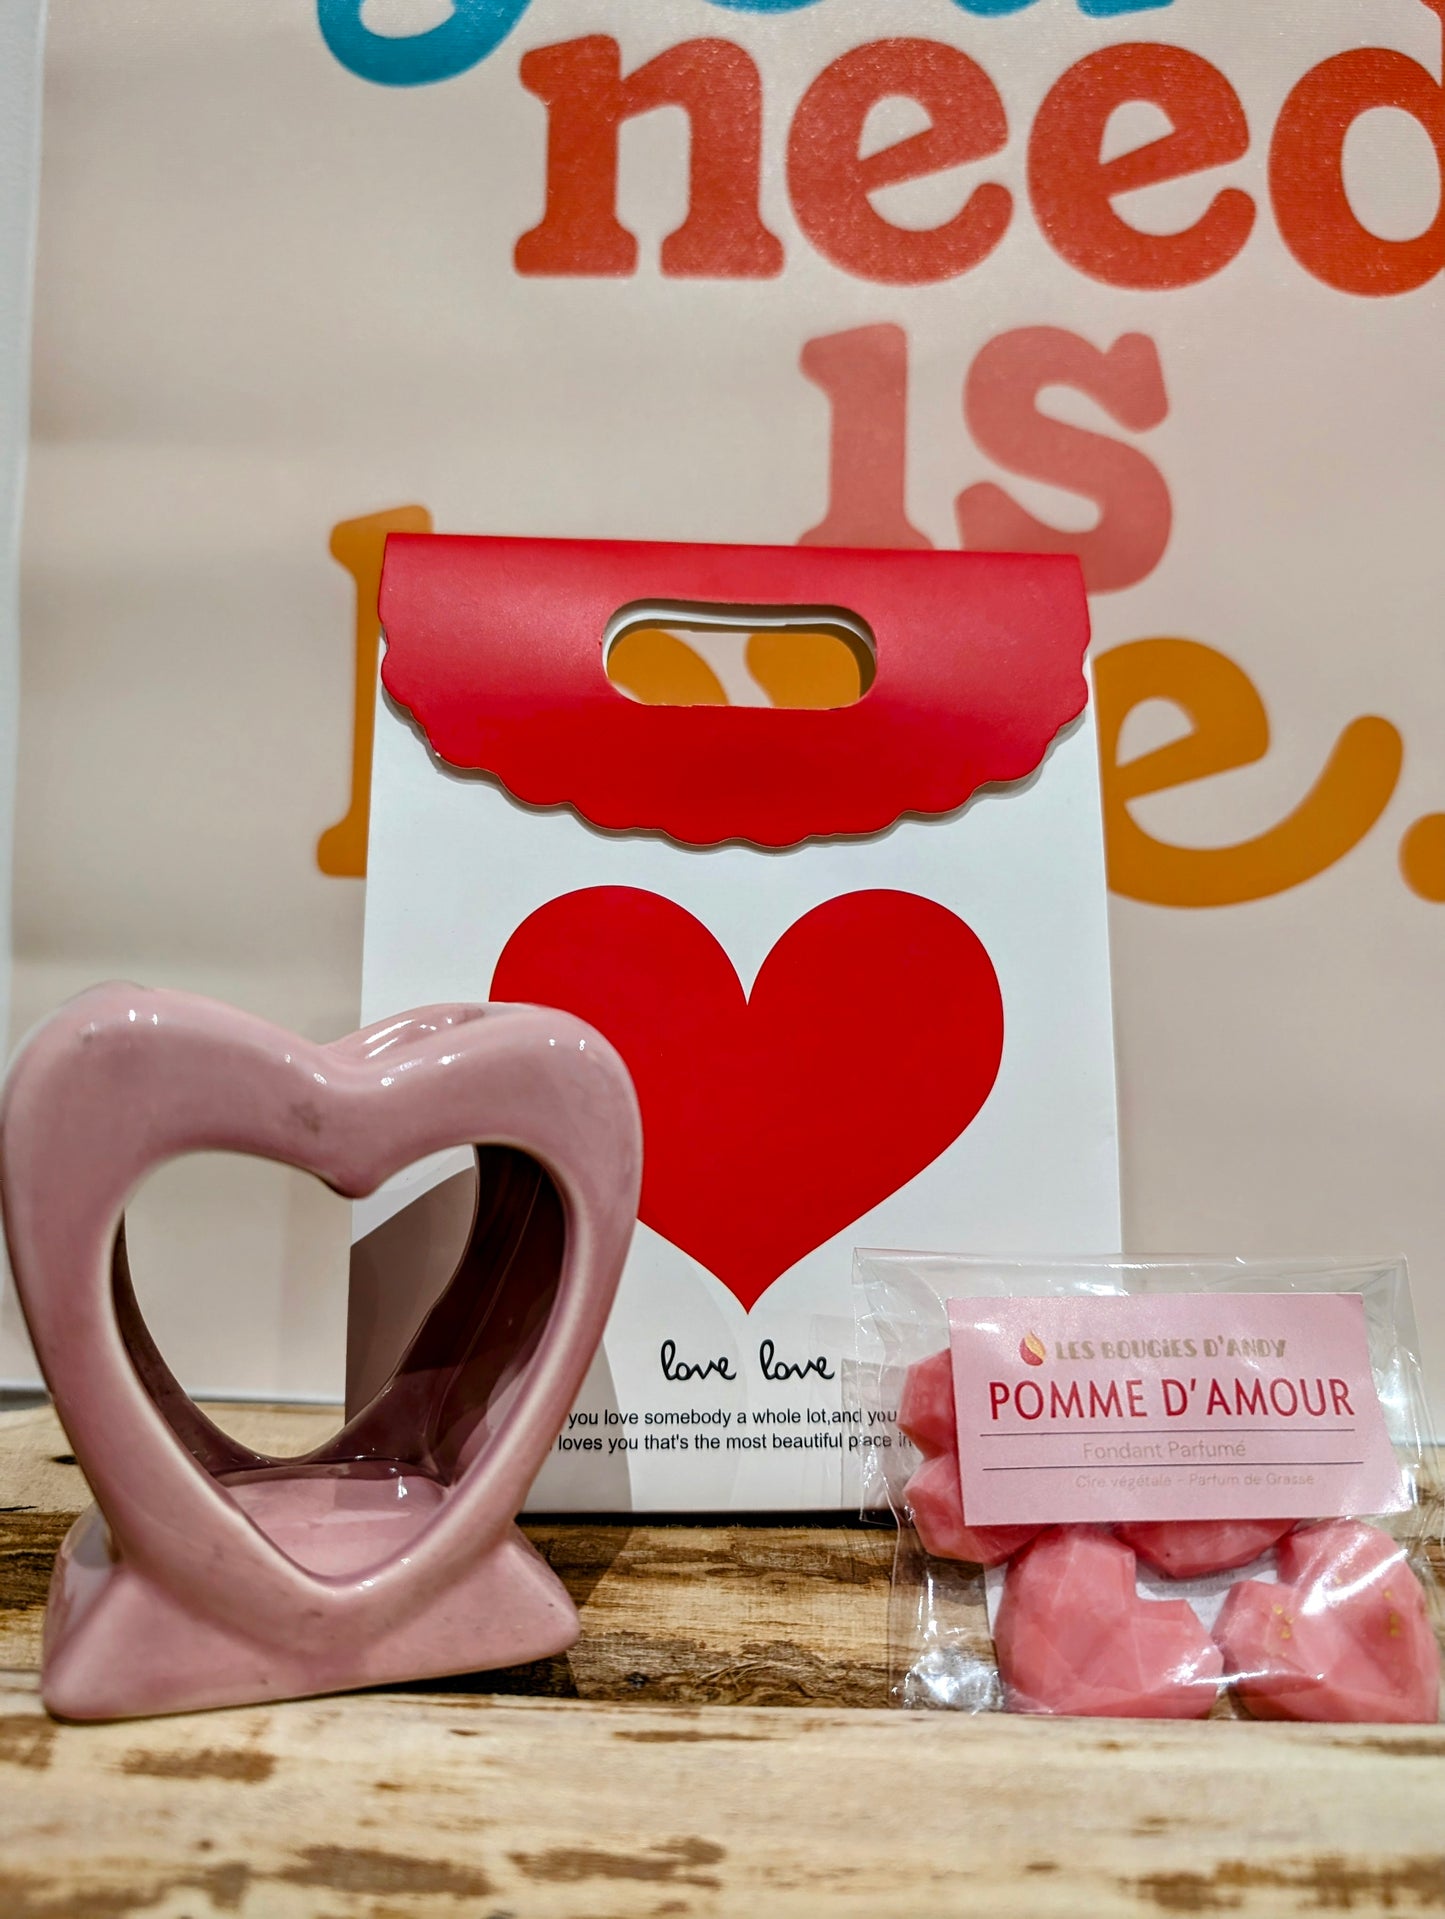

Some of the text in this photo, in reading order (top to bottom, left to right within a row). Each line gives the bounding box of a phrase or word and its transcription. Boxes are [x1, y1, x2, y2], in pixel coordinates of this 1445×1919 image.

[513, 0, 1445, 297] need
[660, 1338, 836, 1381] love love
[1055, 1340, 1096, 1360] LES
[1202, 1335, 1287, 1359] D'ANDY
[988, 1376, 1356, 1421] POMME D'AMOUR
[568, 1412, 599, 1430] you
[603, 1408, 639, 1425] love
[644, 1408, 732, 1429] somebody
[736, 1411, 747, 1425] a
[752, 1407, 802, 1425] whole
[867, 1410, 898, 1427] you
[557, 1433, 603, 1451] loves
[607, 1437, 639, 1455] you
[643, 1433, 690, 1451] that's
[694, 1433, 721, 1450] the
[725, 1433, 768, 1450] most
[771, 1432, 843, 1449] beautiful
[1082, 1439, 1247, 1459] Fondant Parfumé
[1074, 1474, 1106, 1488] Cire
[1188, 1472, 1240, 1486] Parfum
[1243, 1471, 1262, 1486] de
[1265, 1471, 1316, 1486] Grasse
